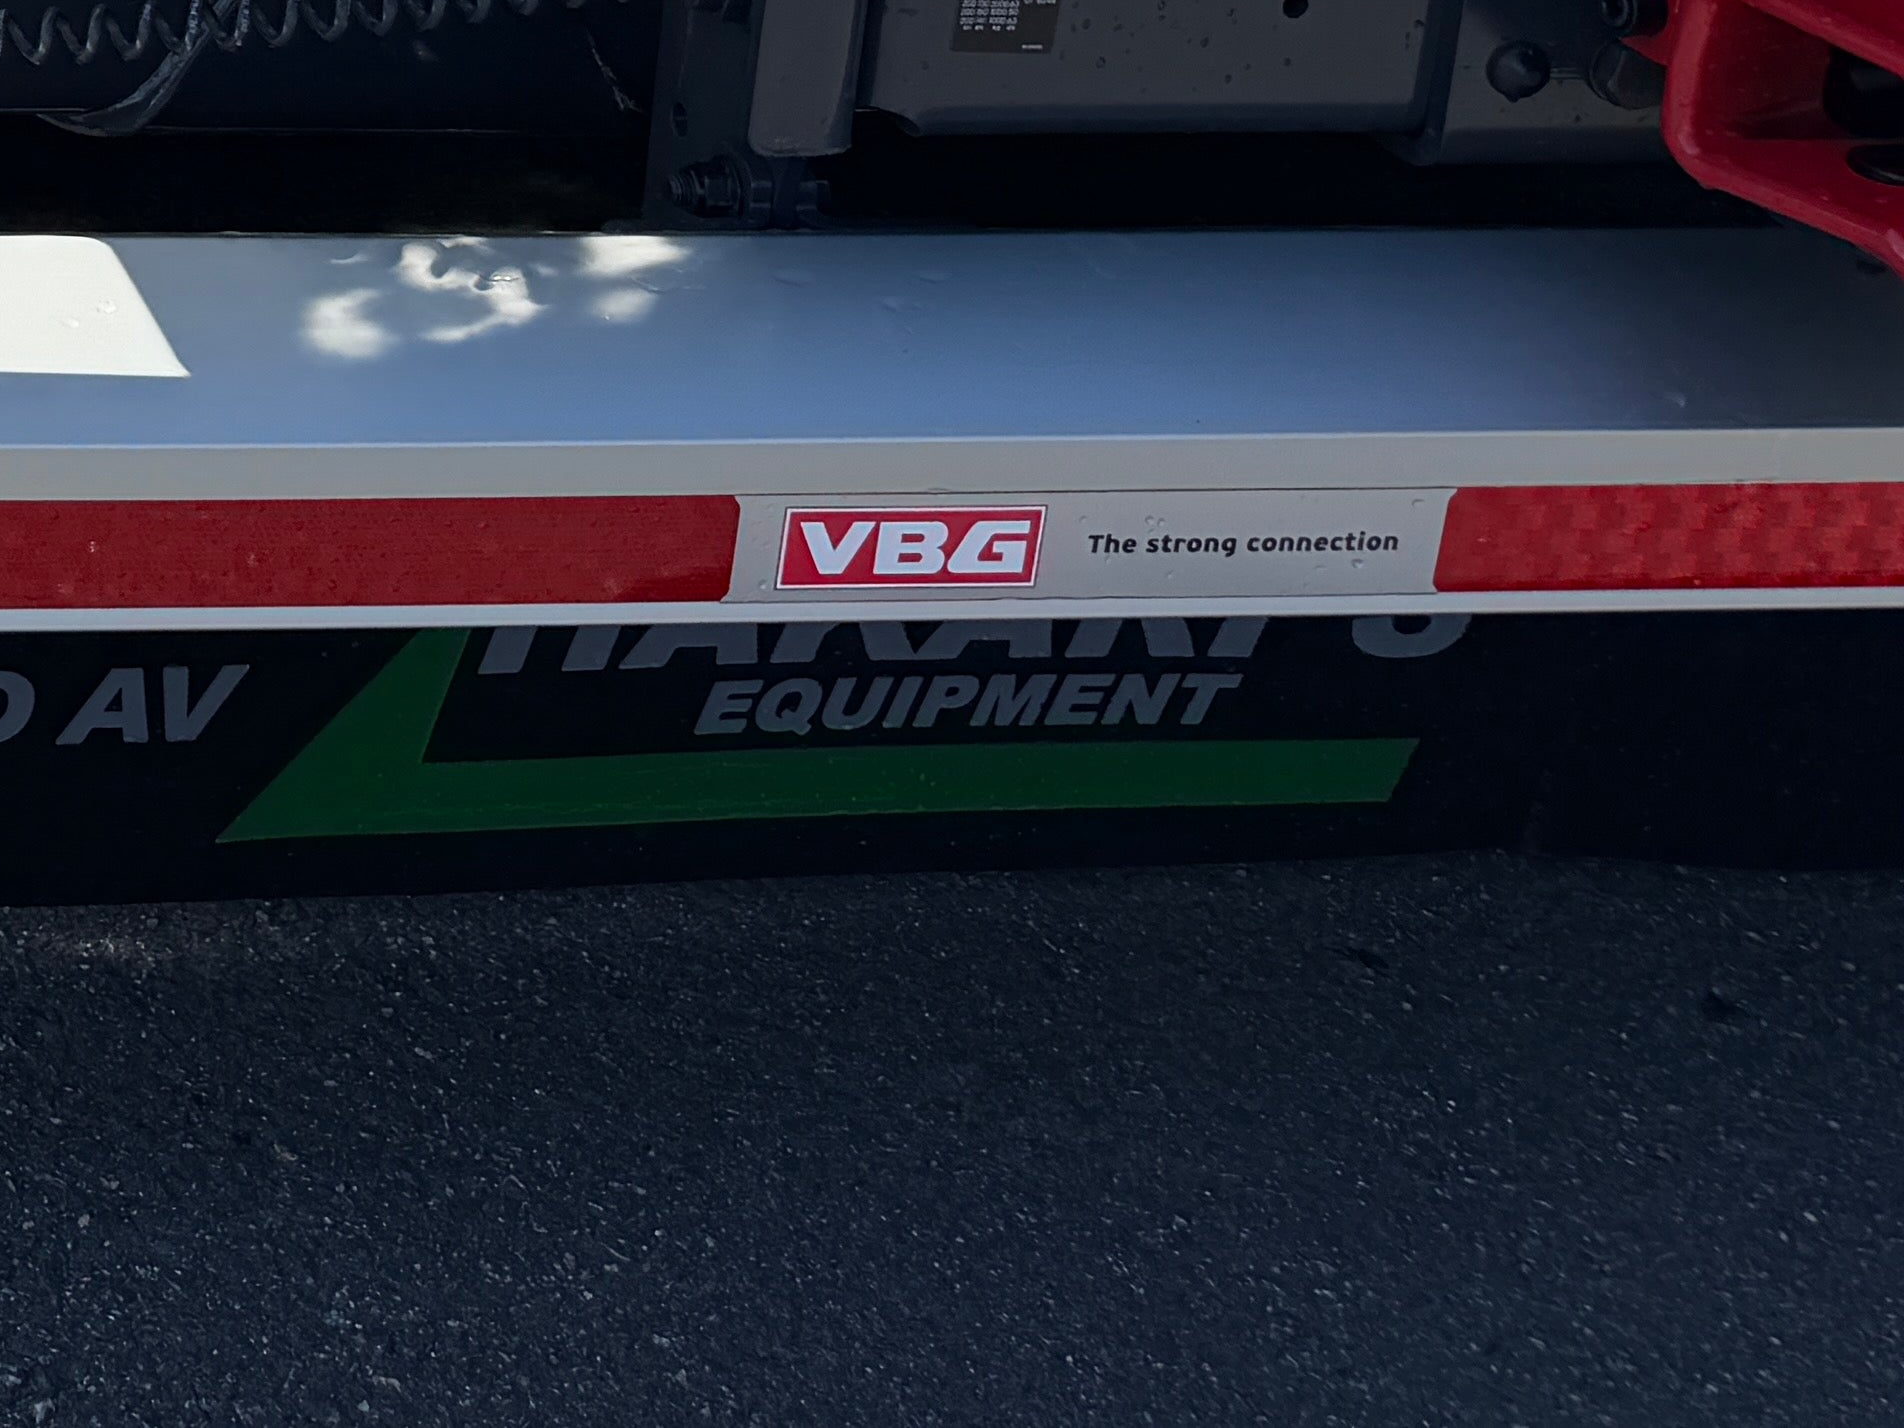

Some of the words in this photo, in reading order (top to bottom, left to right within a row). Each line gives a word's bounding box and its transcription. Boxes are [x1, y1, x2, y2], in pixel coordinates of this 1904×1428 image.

[799, 520, 1031, 575] VBG
[1087, 533, 1138, 554] The
[1145, 534, 1238, 558] strong
[1246, 531, 1399, 553] connection
[54, 664, 250, 746] AV
[694, 674, 1243, 736] EQUIPMENT
